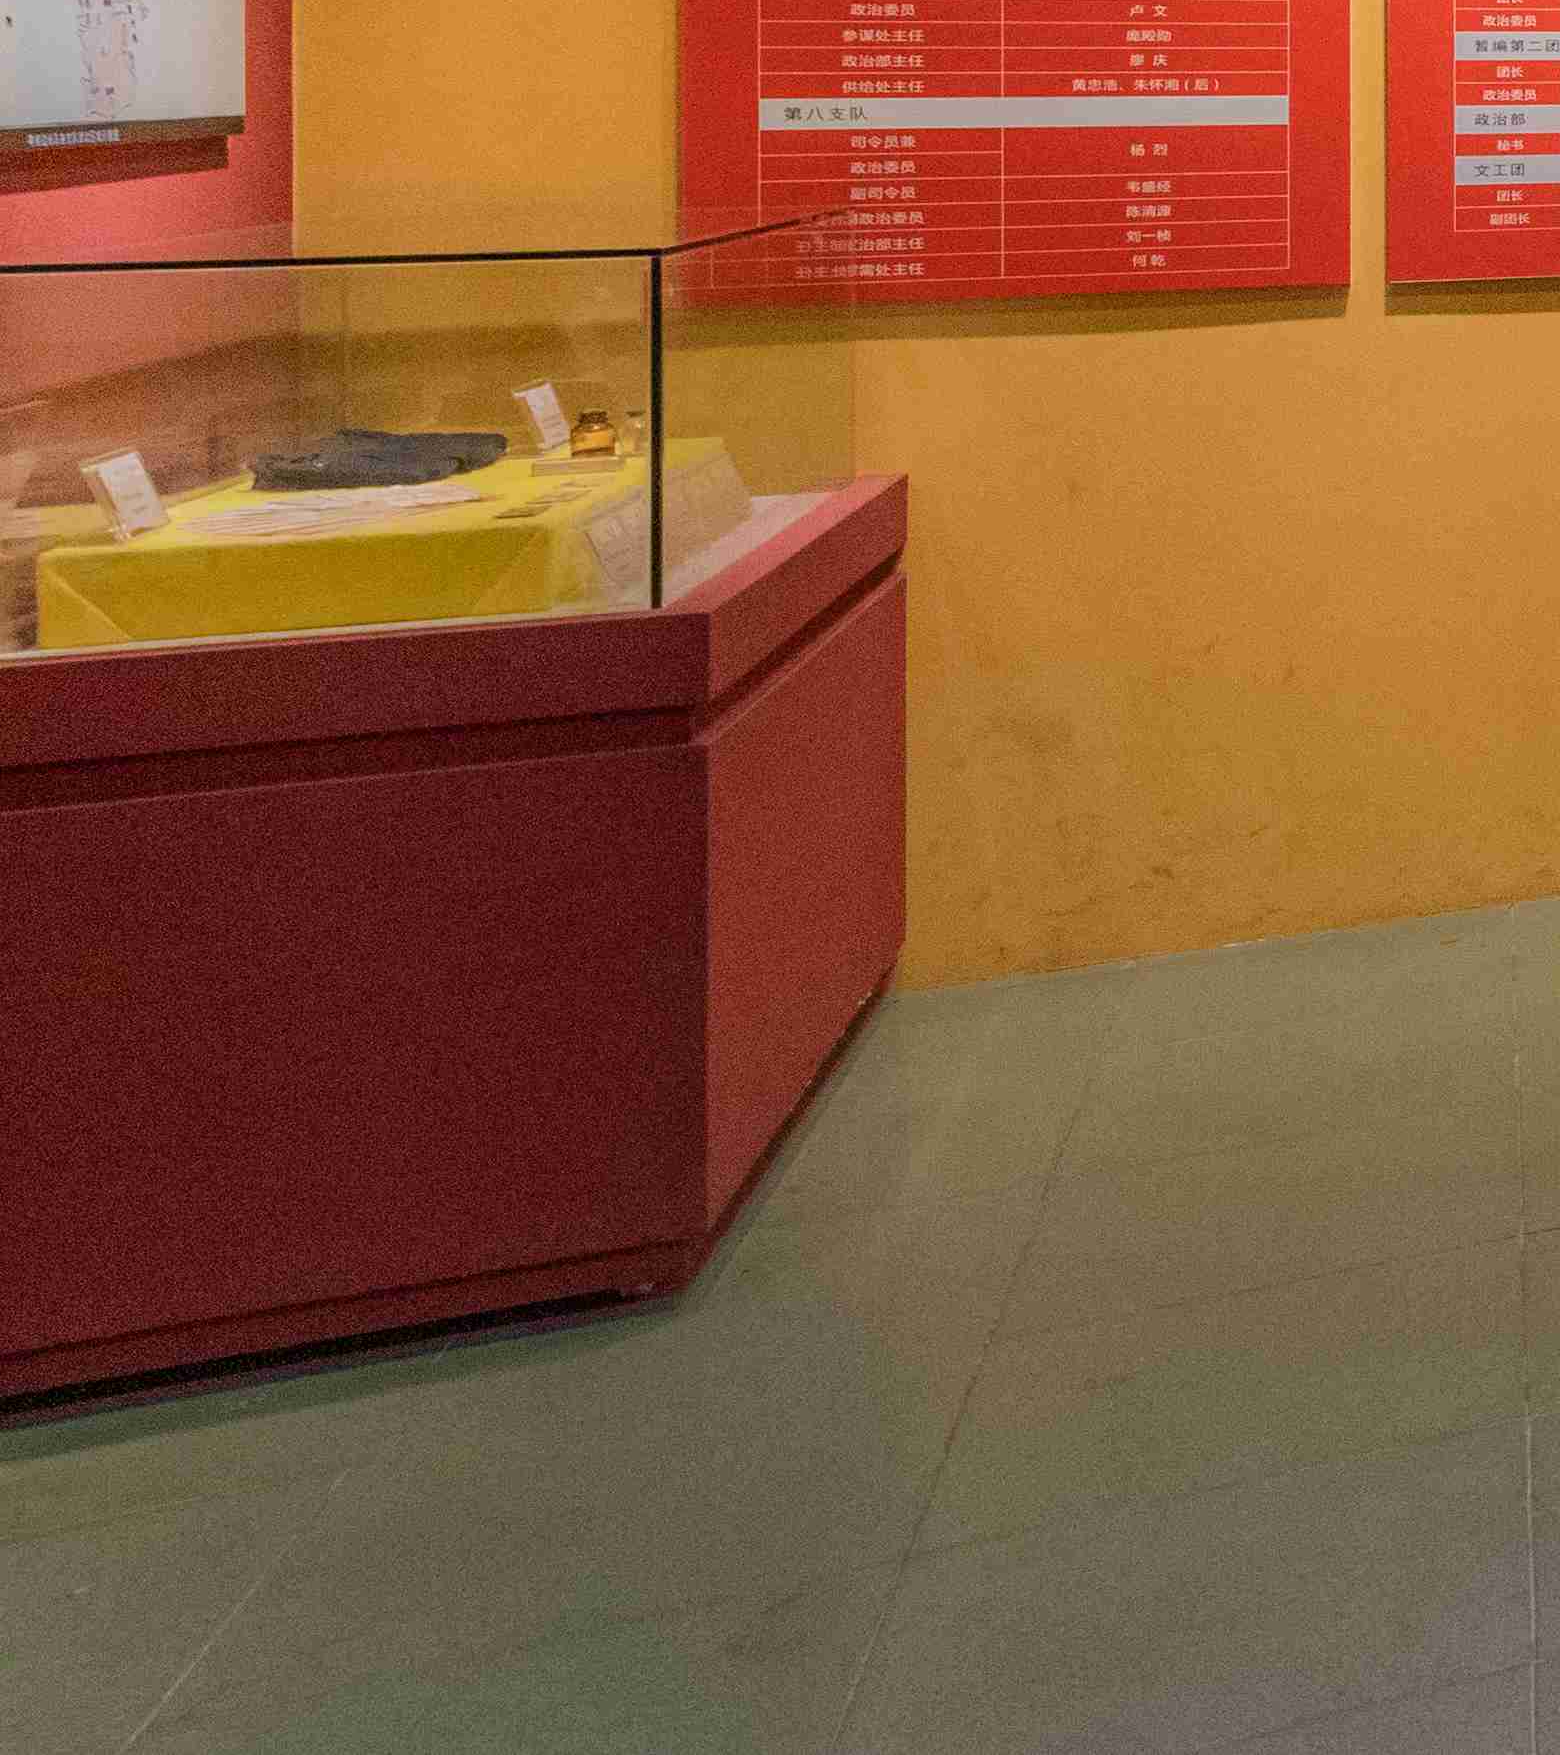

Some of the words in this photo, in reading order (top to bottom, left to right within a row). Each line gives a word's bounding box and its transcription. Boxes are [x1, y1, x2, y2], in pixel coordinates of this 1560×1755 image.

[849, 2, 915, 17] 政治委员
[1482, 14, 1536, 27] 政治委员
[841, 28, 923, 42] 参谋处主任
[841, 53, 923, 67] 政治部主任
[841, 79, 923, 93] 供给处主任
[1482, 88, 1536, 102] 政治委员
[783, 105, 867, 123] 第八支队
[1474, 113, 1526, 126] 政治部
[849, 134, 915, 149] 司令员兼
[849, 159, 915, 174] 政治委员
[1474, 163, 1524, 177] 文工团
[849, 184, 915, 199] 副司令员
